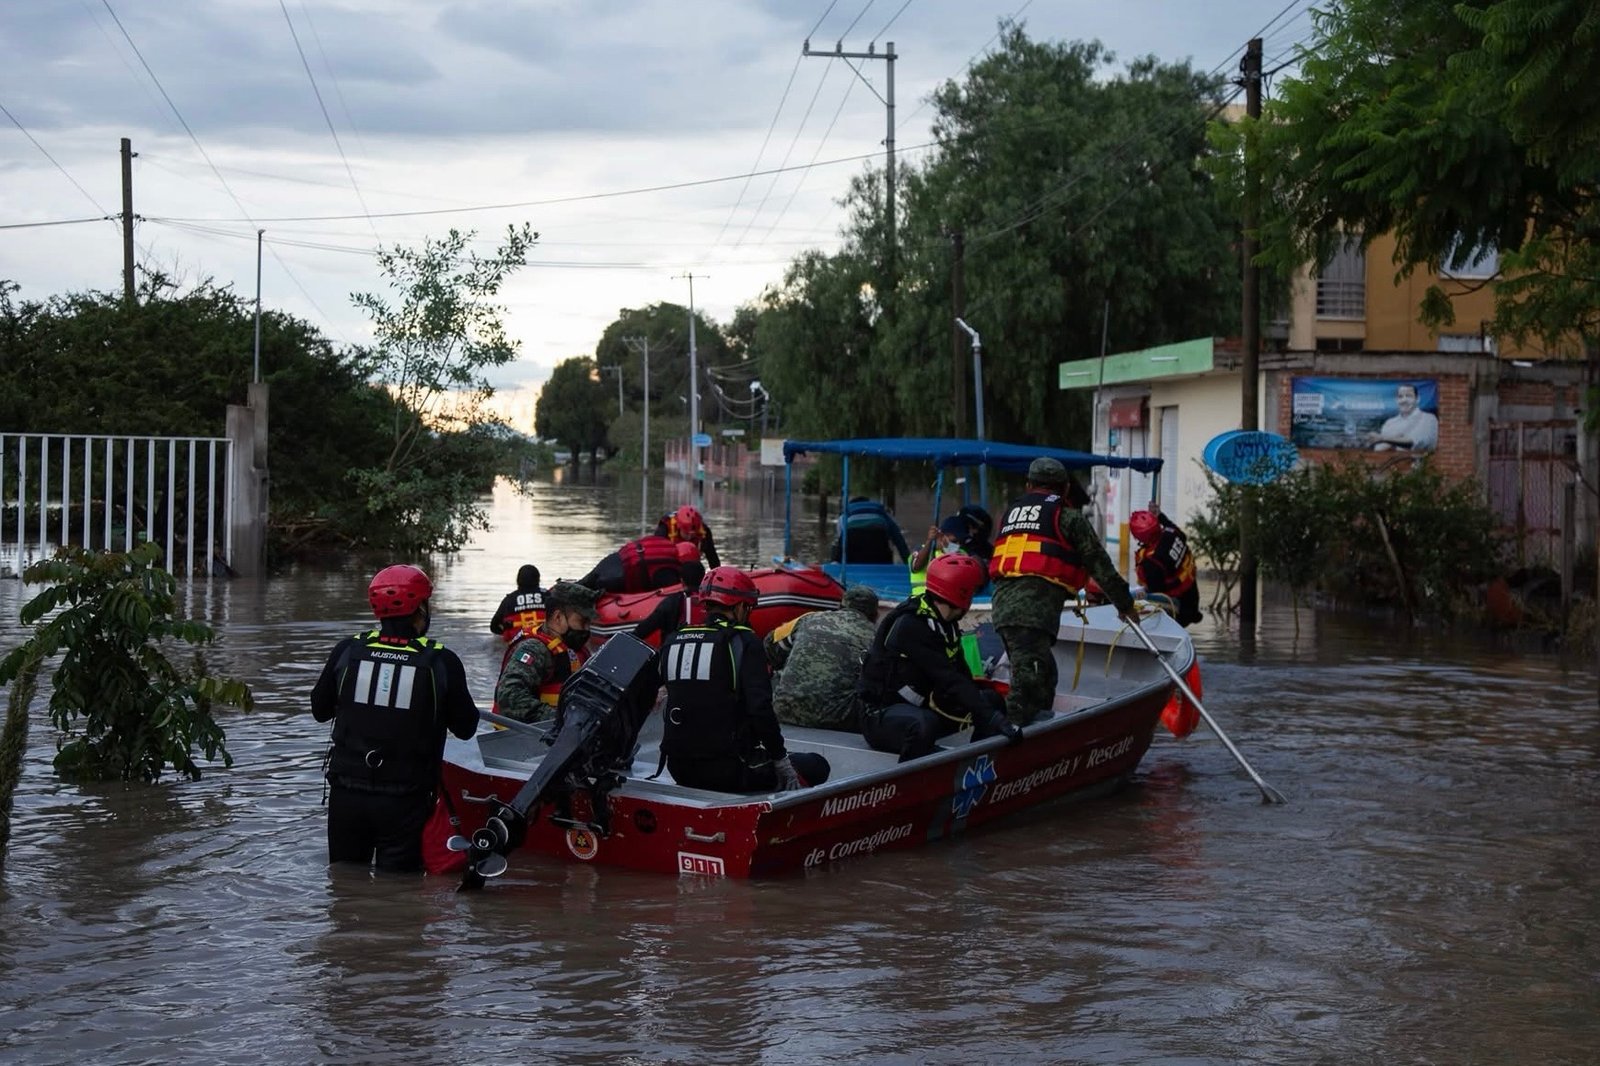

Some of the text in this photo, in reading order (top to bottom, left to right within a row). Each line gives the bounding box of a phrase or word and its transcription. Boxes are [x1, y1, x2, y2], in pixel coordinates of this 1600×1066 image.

[1007, 505, 1042, 524] OES
[516, 593, 543, 606] OES
[370, 651, 410, 661] MUSTANG
[988, 757, 1071, 805] Emergencia
[1086, 736, 1135, 769] Rescate
[819, 781, 897, 819] Municipio
[803, 821, 913, 869] de Corregidora
[683, 859, 719, 874] 911
